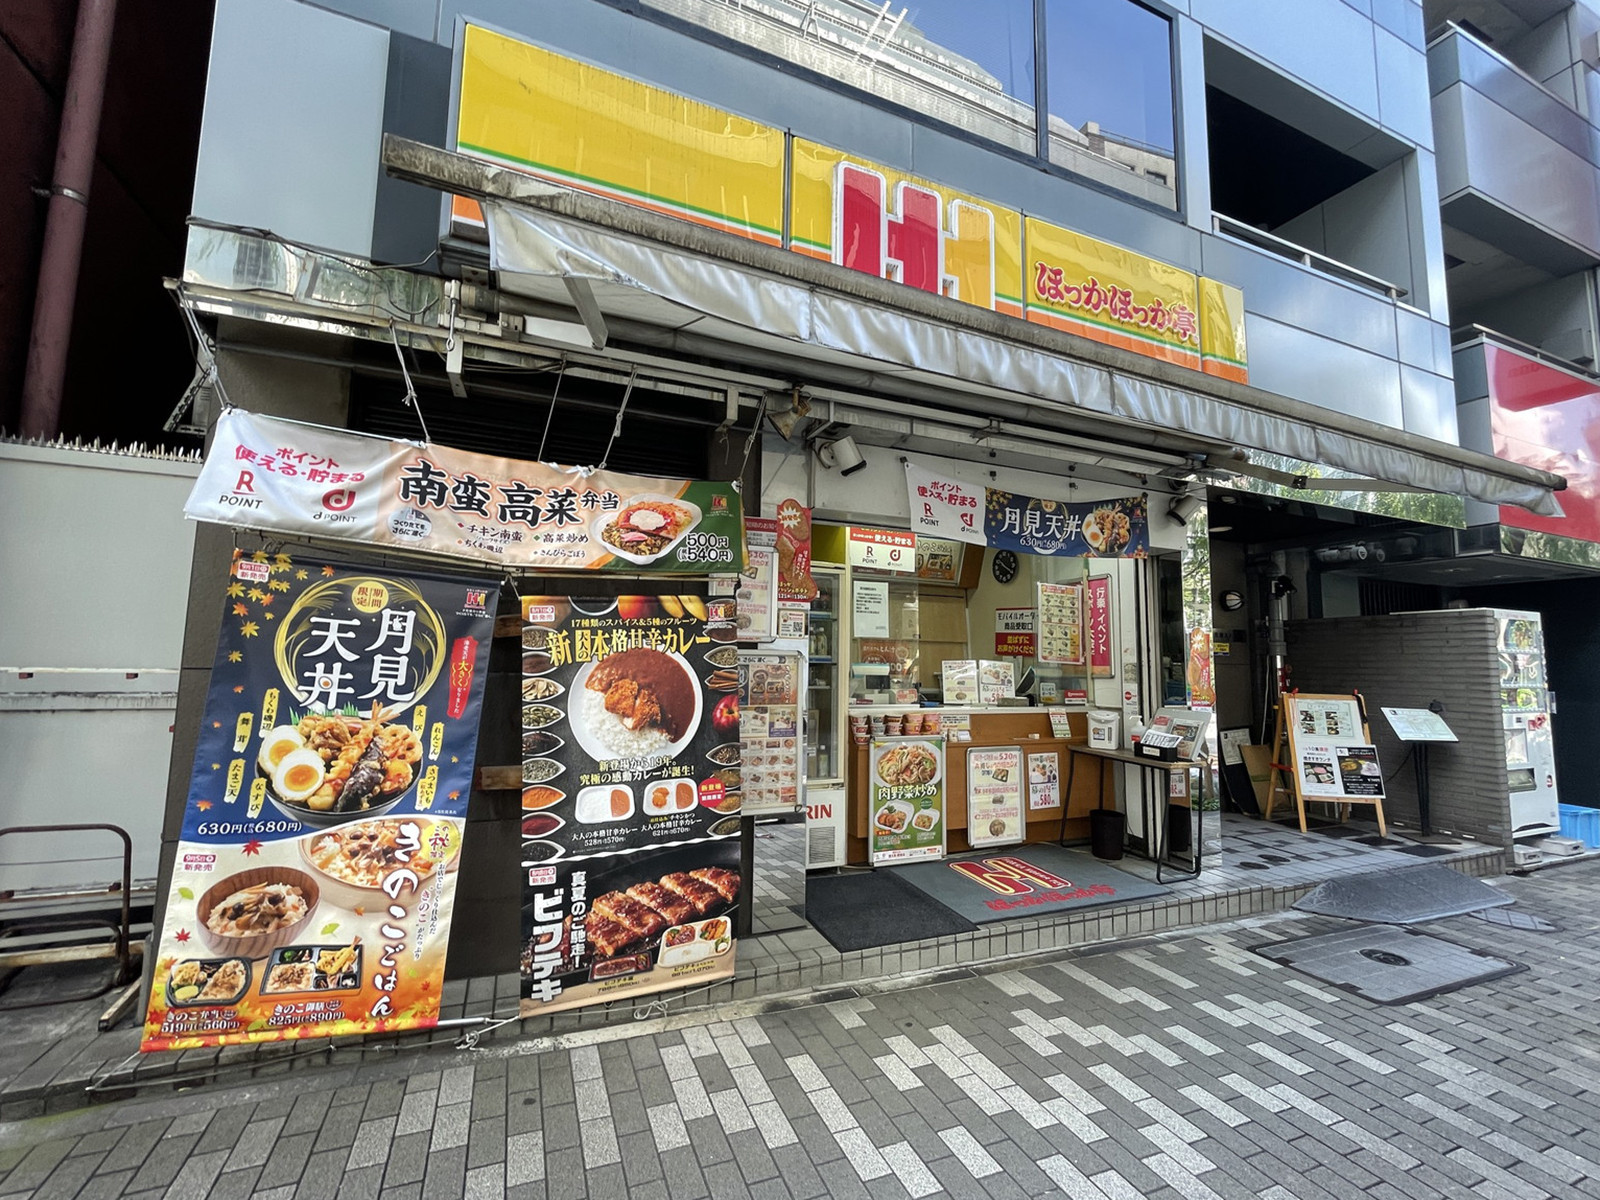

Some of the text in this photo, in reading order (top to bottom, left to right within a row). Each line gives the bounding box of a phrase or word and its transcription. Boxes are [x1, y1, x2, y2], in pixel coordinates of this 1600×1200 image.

[1035, 261, 1199, 344] ほっかほっか亭
[275, 448, 339, 469] ポイント
[398, 457, 621, 528] 南蛮高菜弁当
[931, 481, 962, 493] ポイント
[218, 494, 263, 510] POINT
[323, 513, 357, 523] POINT
[920, 517, 939, 527] POINT
[466, 525, 523, 542] チキン南蛮
[542, 533, 589, 544] 高菜炒め
[686, 533, 729, 548] 500円
[357, 608, 417, 702] 月見
[546, 629, 572, 667] 新
[590, 628, 711, 662] 本格甘辛カレー
[998, 644, 1034, 654] お声がけくださ
[414, 709, 424, 731] えび
[430, 726, 442, 756] れんこん
[228, 763, 242, 797] たまご天
[250, 782, 264, 812] なすび
[878, 785, 937, 800] 肉野菜炒め
[428, 832, 450, 851] 秋
[184, 863, 213, 872] 新発売
[370, 822, 423, 1018] きのこごはん
[531, 888, 565, 1002] ビフテキ
[166, 1010, 220, 1023] きのこ弁当
